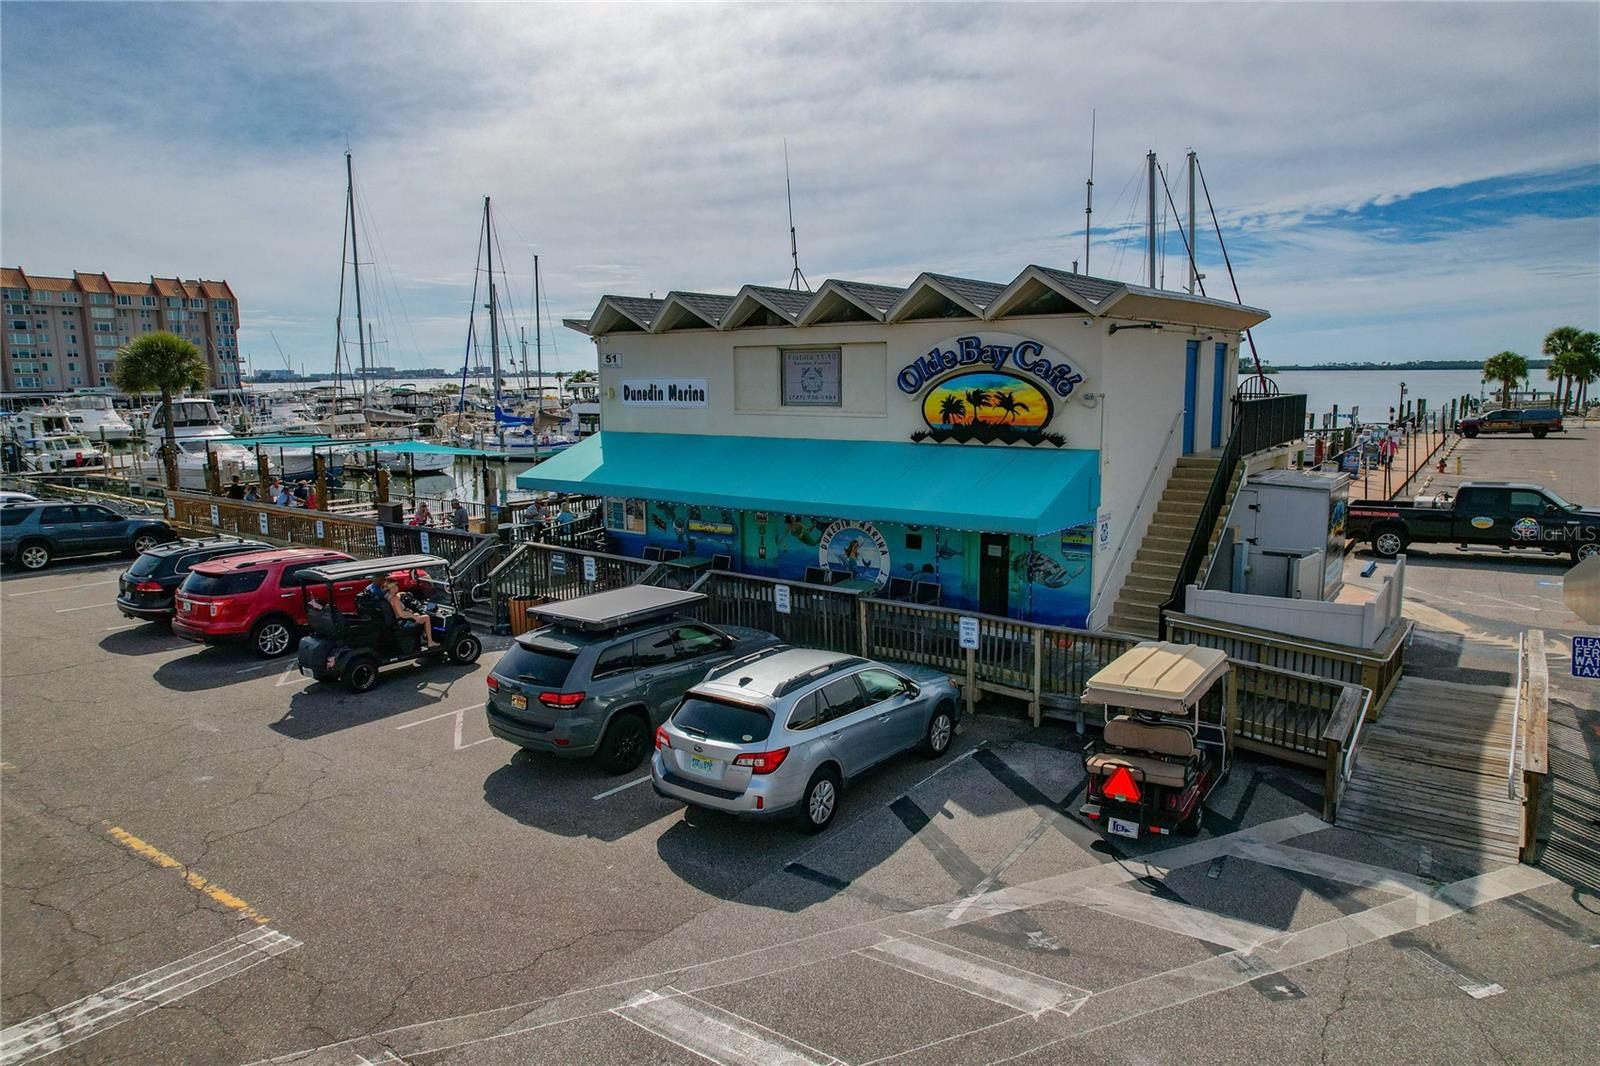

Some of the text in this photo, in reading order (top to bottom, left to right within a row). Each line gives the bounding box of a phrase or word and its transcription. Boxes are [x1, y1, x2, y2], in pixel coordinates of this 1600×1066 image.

[605, 354, 617, 364] 51
[897, 336, 1083, 397] Olde Bay Café
[623, 384, 705, 401] Dunedin Marina
[820, 520, 888, 556] DUNEDIN MARINA
[1574, 638, 1600, 648] CLEA
[1575, 647, 1600, 658] FER
[1575, 656, 1600, 666] WAT
[1575, 666, 1600, 677] TAX
